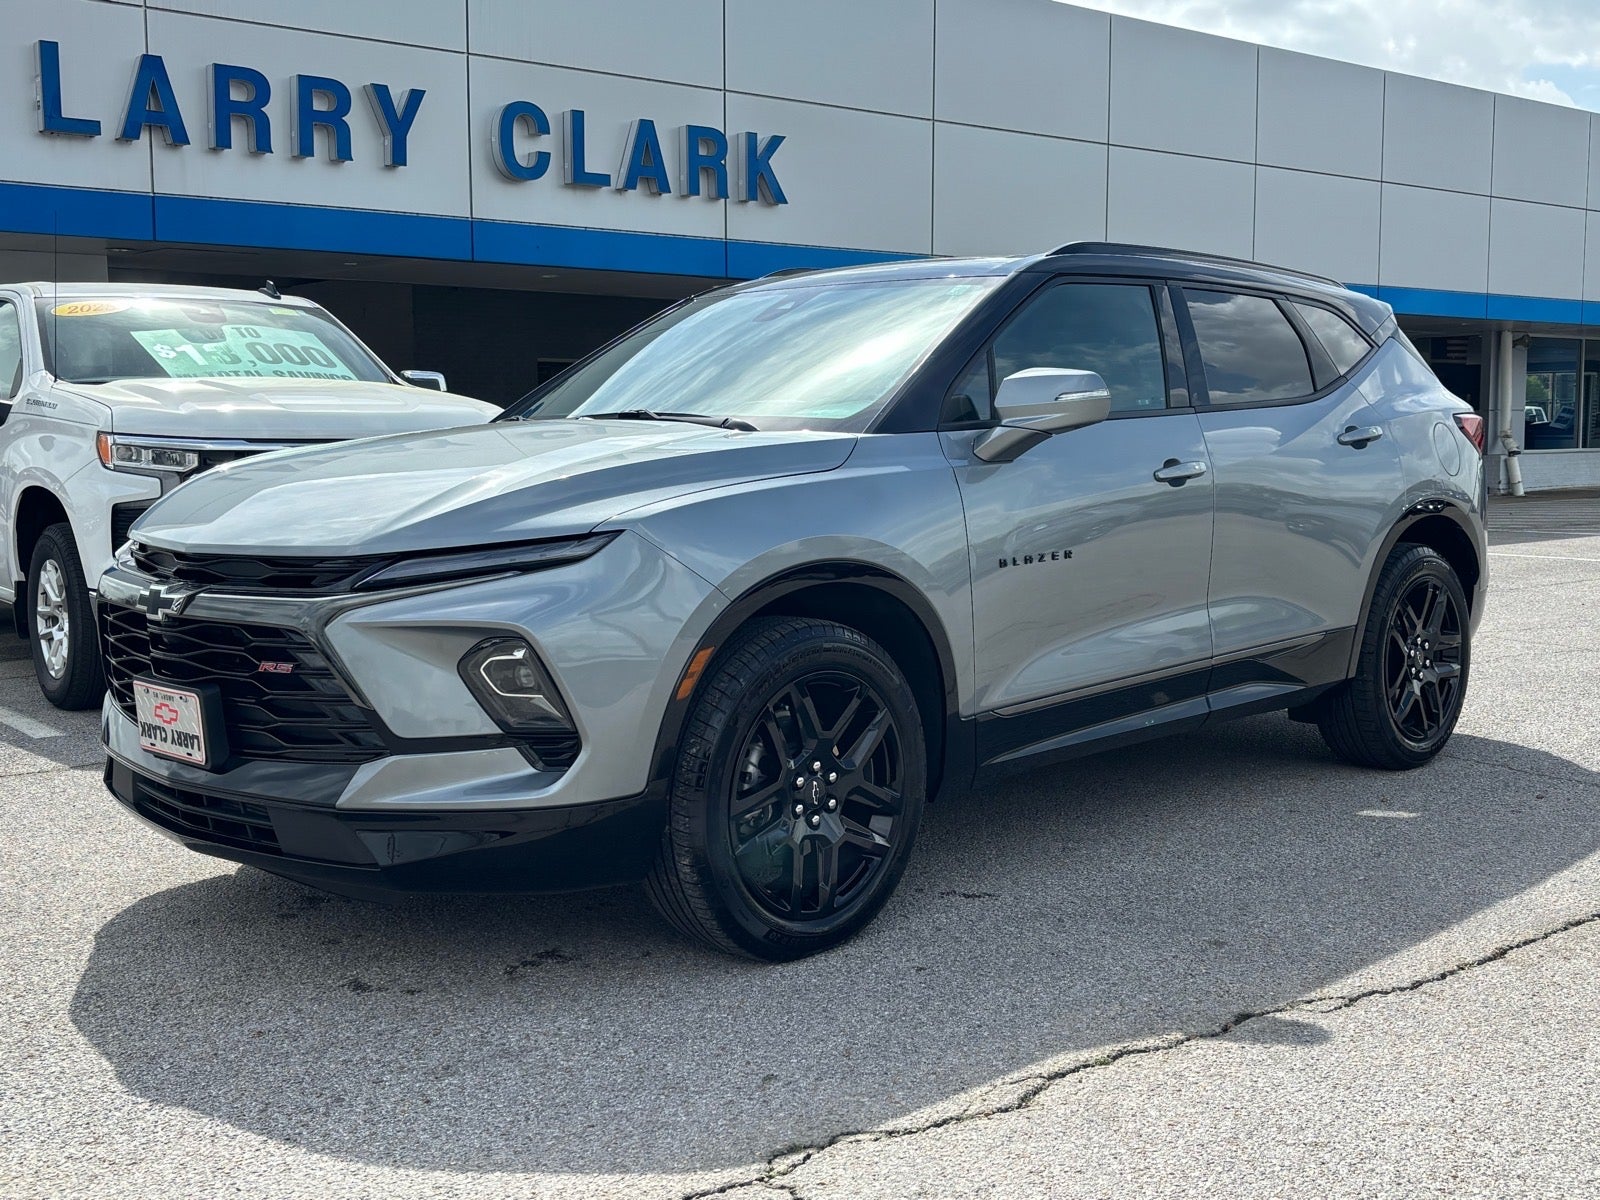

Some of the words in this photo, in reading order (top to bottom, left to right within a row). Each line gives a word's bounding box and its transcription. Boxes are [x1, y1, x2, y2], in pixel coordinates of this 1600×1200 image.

[33, 40, 426, 169] LARRY
[491, 100, 789, 206] CLARK
[66, 303, 115, 315] 202
[231, 326, 262, 339] TO
[998, 549, 1074, 568] BLAZER
[258, 660, 294, 674] RS
[139, 720, 168, 743] CLARK
[170, 729, 201, 752] LARRY
